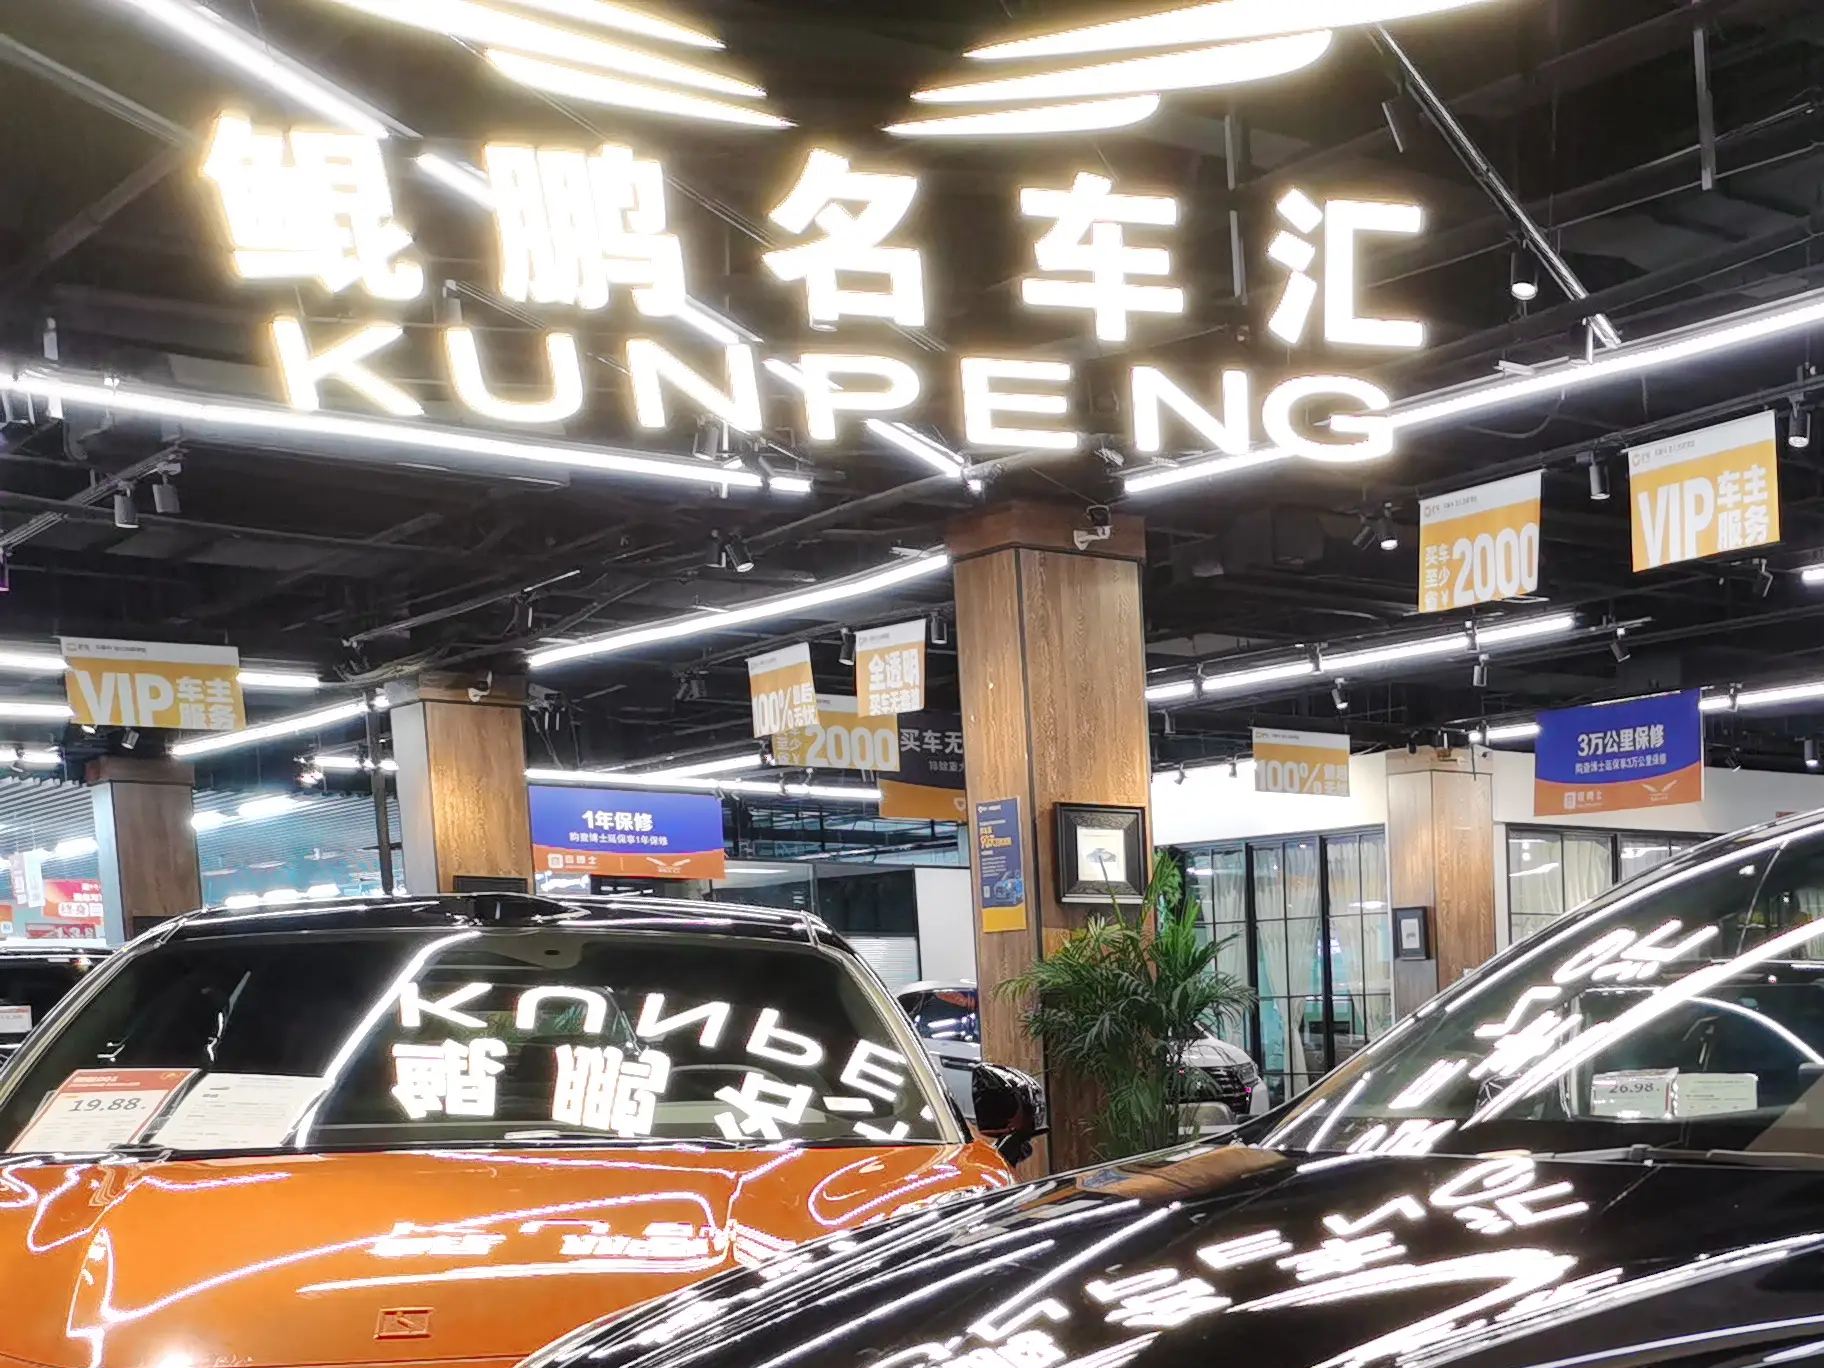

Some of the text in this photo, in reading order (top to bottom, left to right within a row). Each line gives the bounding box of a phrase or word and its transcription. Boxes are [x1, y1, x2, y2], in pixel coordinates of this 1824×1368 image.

[271, 317, 1393, 461] KUNPENG
[1717, 464, 1768, 508] 车主
[1638, 477, 1714, 568] VIP
[1717, 505, 1769, 550] 服务
[1424, 566, 1450, 588] 至少
[1452, 522, 1539, 607] 2000
[176, 676, 234, 703] 车主
[869, 649, 919, 691] 全透明
[75, 671, 174, 727] VIP
[805, 725, 898, 770] 2000
[1577, 724, 1664, 756] 3万公里保修
[1256, 760, 1322, 794] 100%
[582, 811, 653, 832] 1年保修
